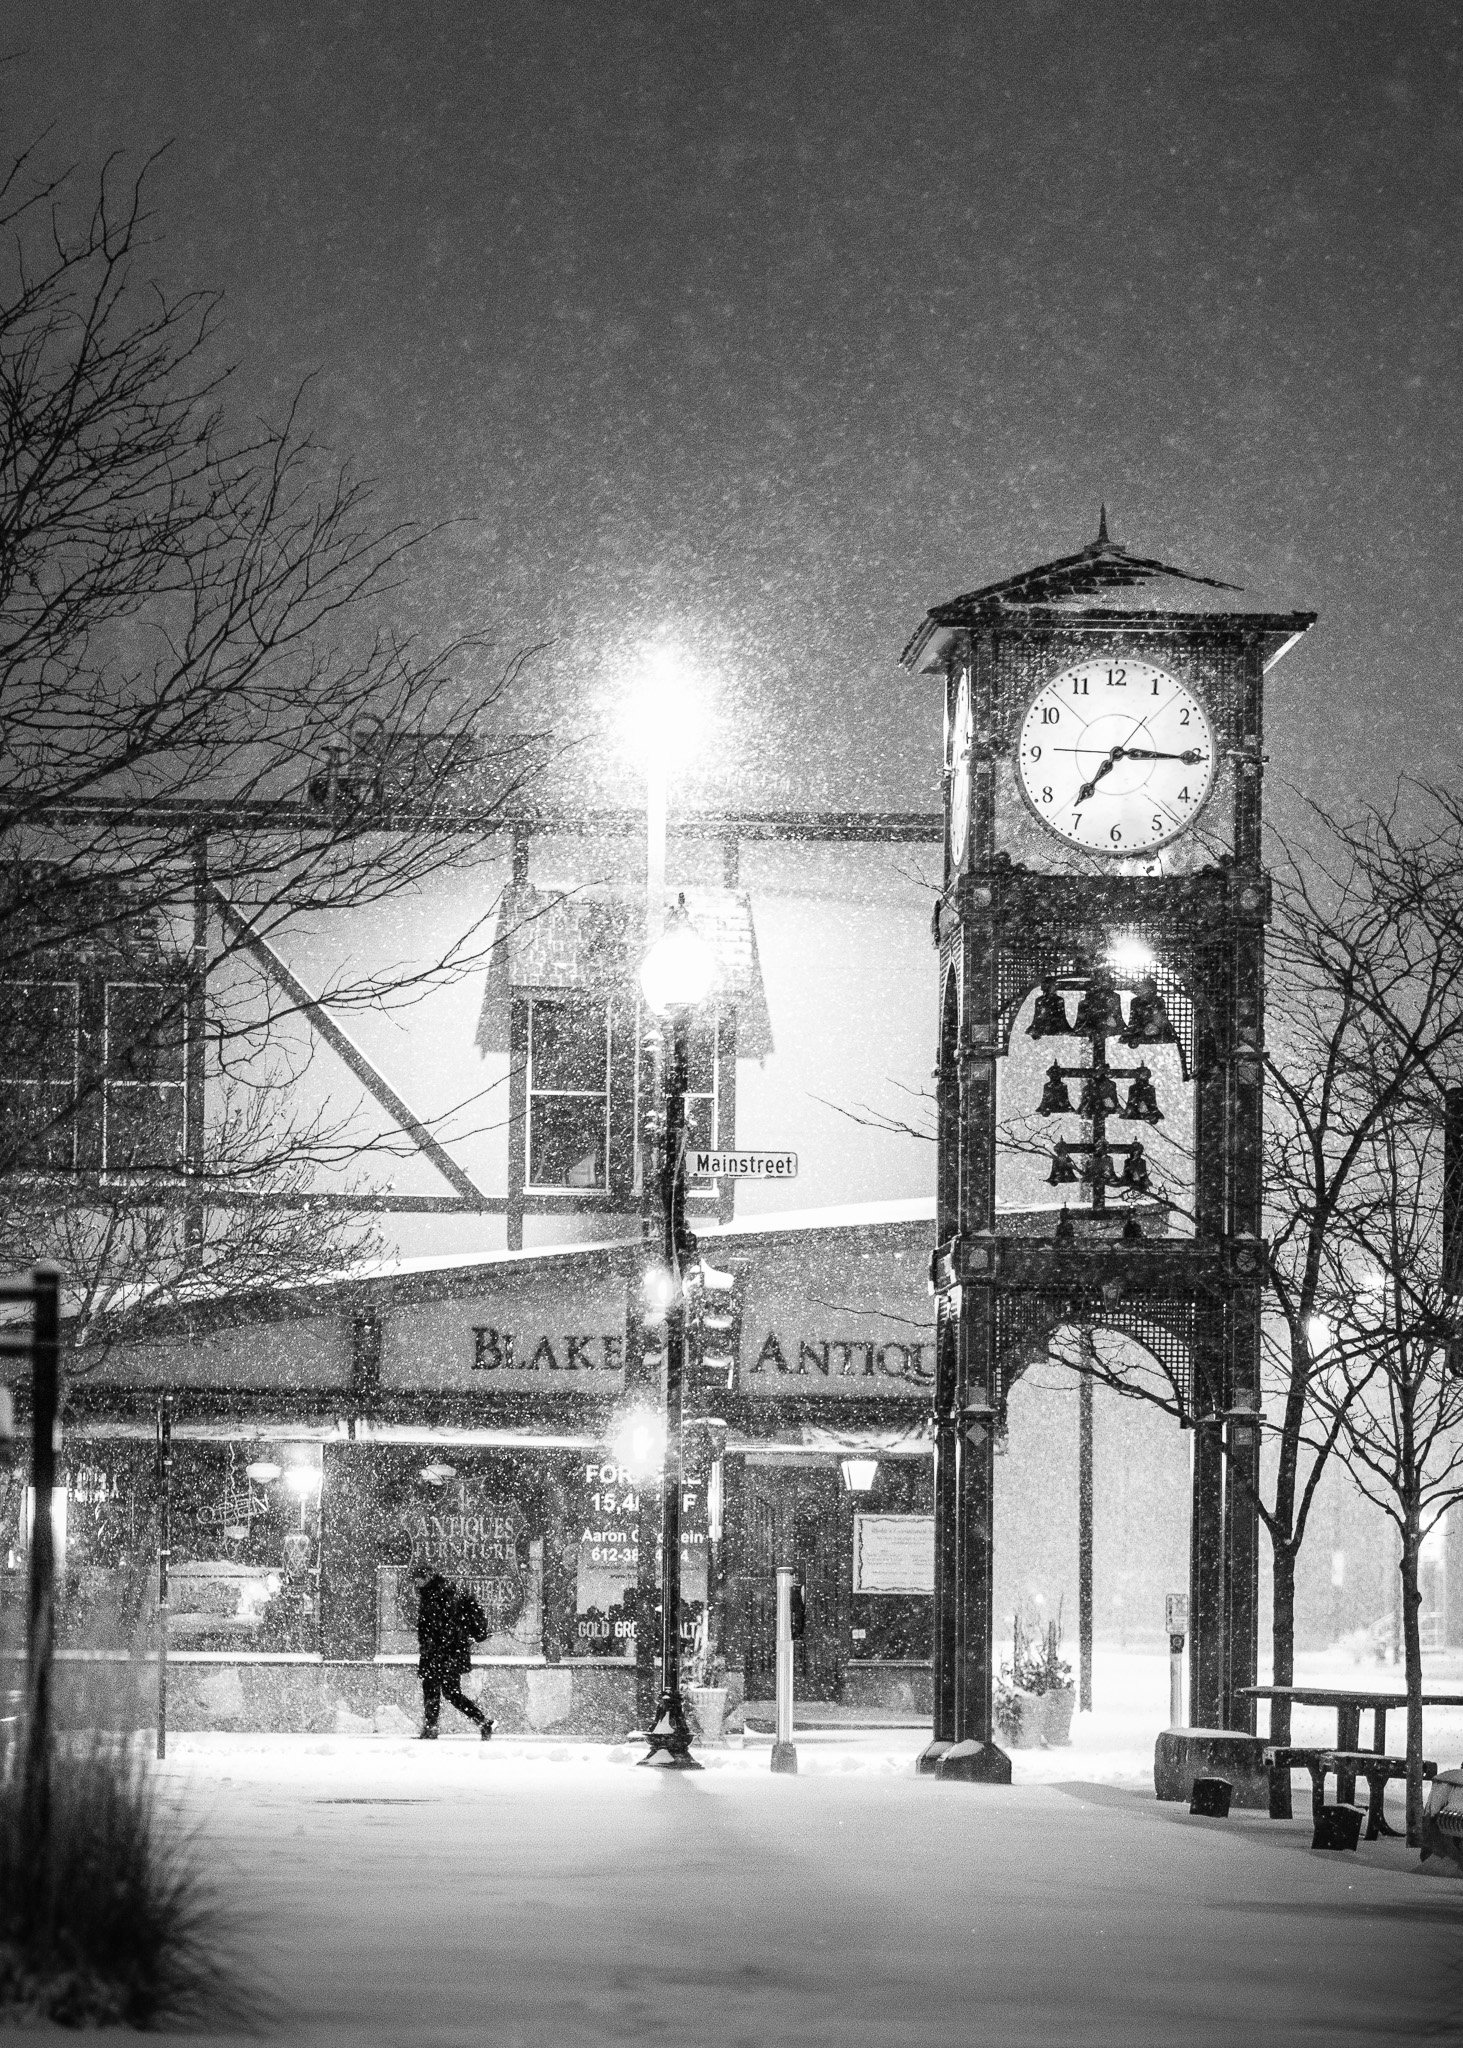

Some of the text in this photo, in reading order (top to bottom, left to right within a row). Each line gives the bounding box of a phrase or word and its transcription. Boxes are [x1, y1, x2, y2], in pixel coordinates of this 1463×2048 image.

[1072, 677, 1090, 696] 11
[1105, 668, 1127, 687] 12
[1150, 678, 1160, 696] 1
[1040, 707, 1060, 725] 10
[1179, 708, 1191, 726] 2
[1030, 745, 1042, 763] 9
[1042, 786, 1054, 803] 8
[1177, 786, 1191, 803] 4
[1072, 813, 1083, 830] 7
[1151, 814, 1163, 831] 5
[1110, 824, 1122, 842] 6
[697, 1154, 792, 1174] Mainstreet
[196, 1492, 269, 1525] OPEN
[412, 1516, 515, 1542] ANTIQUES
[581, 1527, 627, 1543] Aaron
[578, 1621, 610, 1639] GOLD
